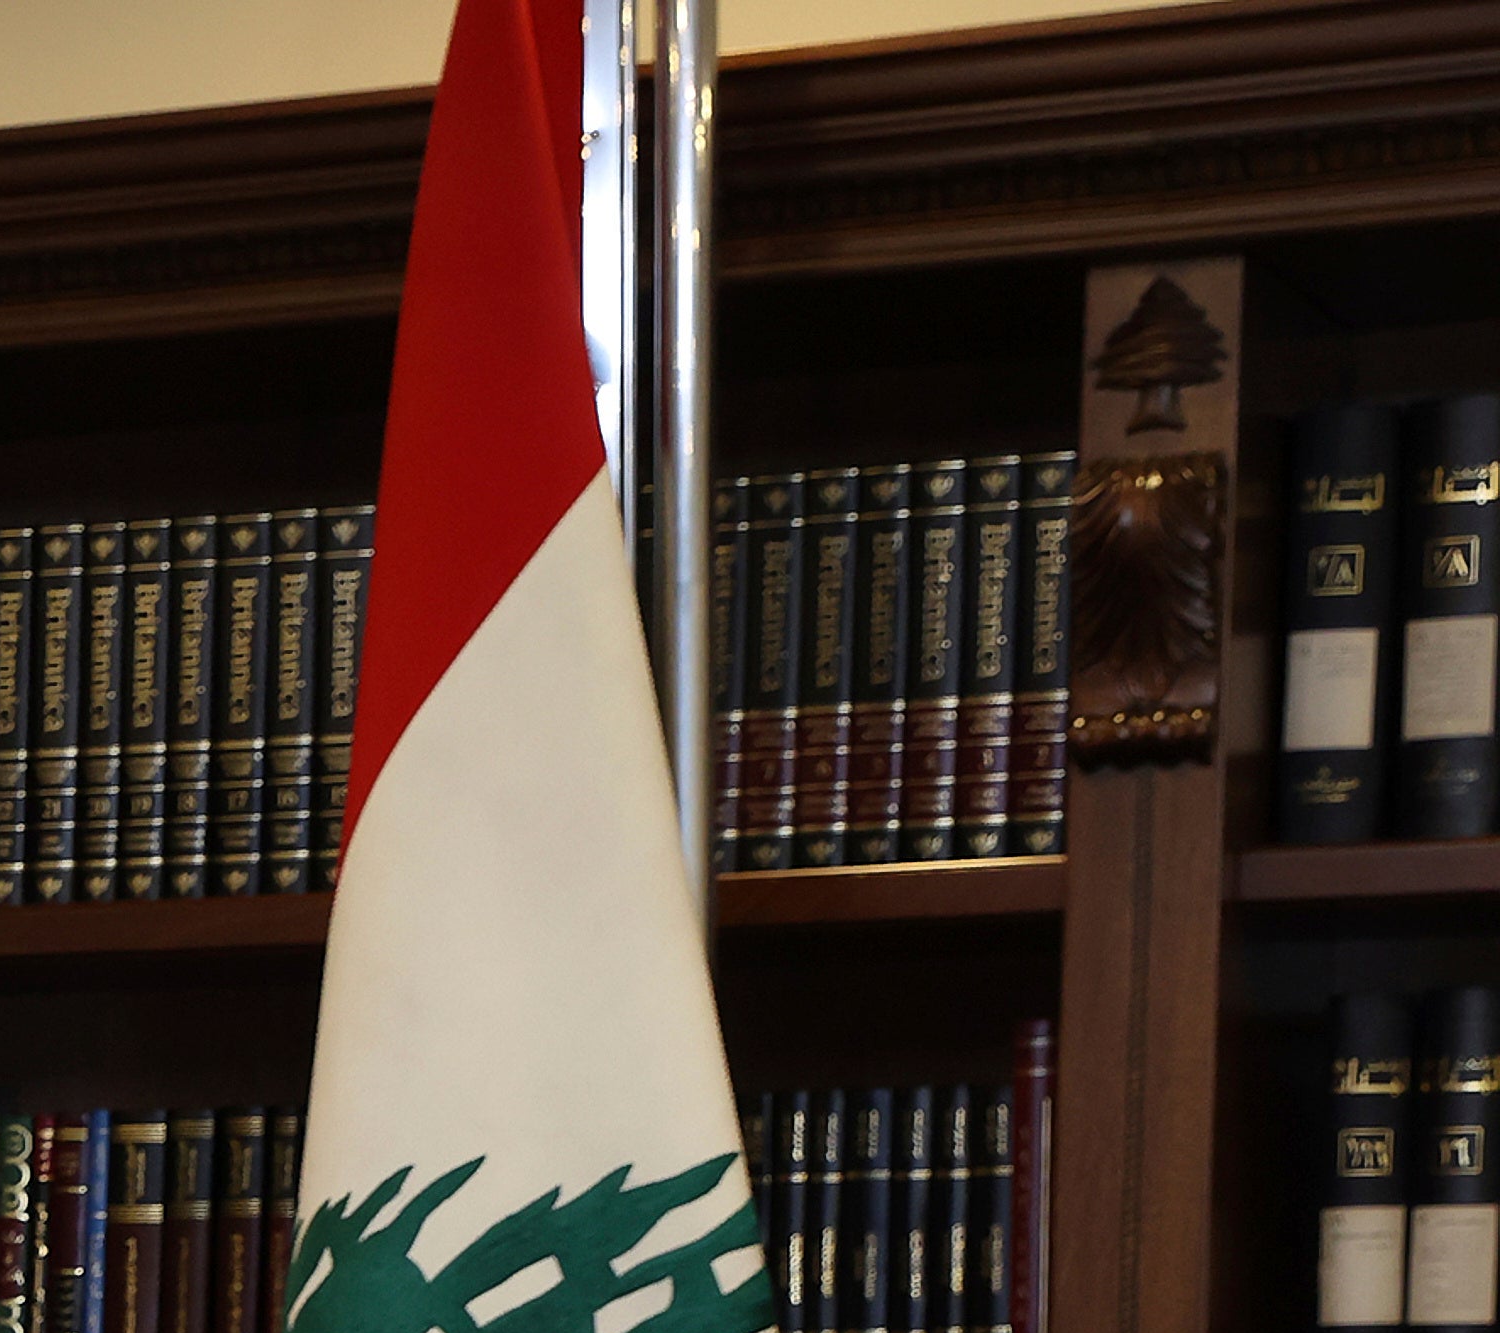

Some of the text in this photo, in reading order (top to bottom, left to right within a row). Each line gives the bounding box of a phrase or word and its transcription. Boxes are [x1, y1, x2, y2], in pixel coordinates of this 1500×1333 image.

[43, 588, 73, 732] Britannica
[88, 584, 119, 731] Britannica
[132, 583, 163, 728] Britannica
[178, 579, 210, 725] Britannica
[228, 577, 260, 724] Britannica
[277, 572, 309, 721] Britannica
[330, 570, 361, 718] Britannica
